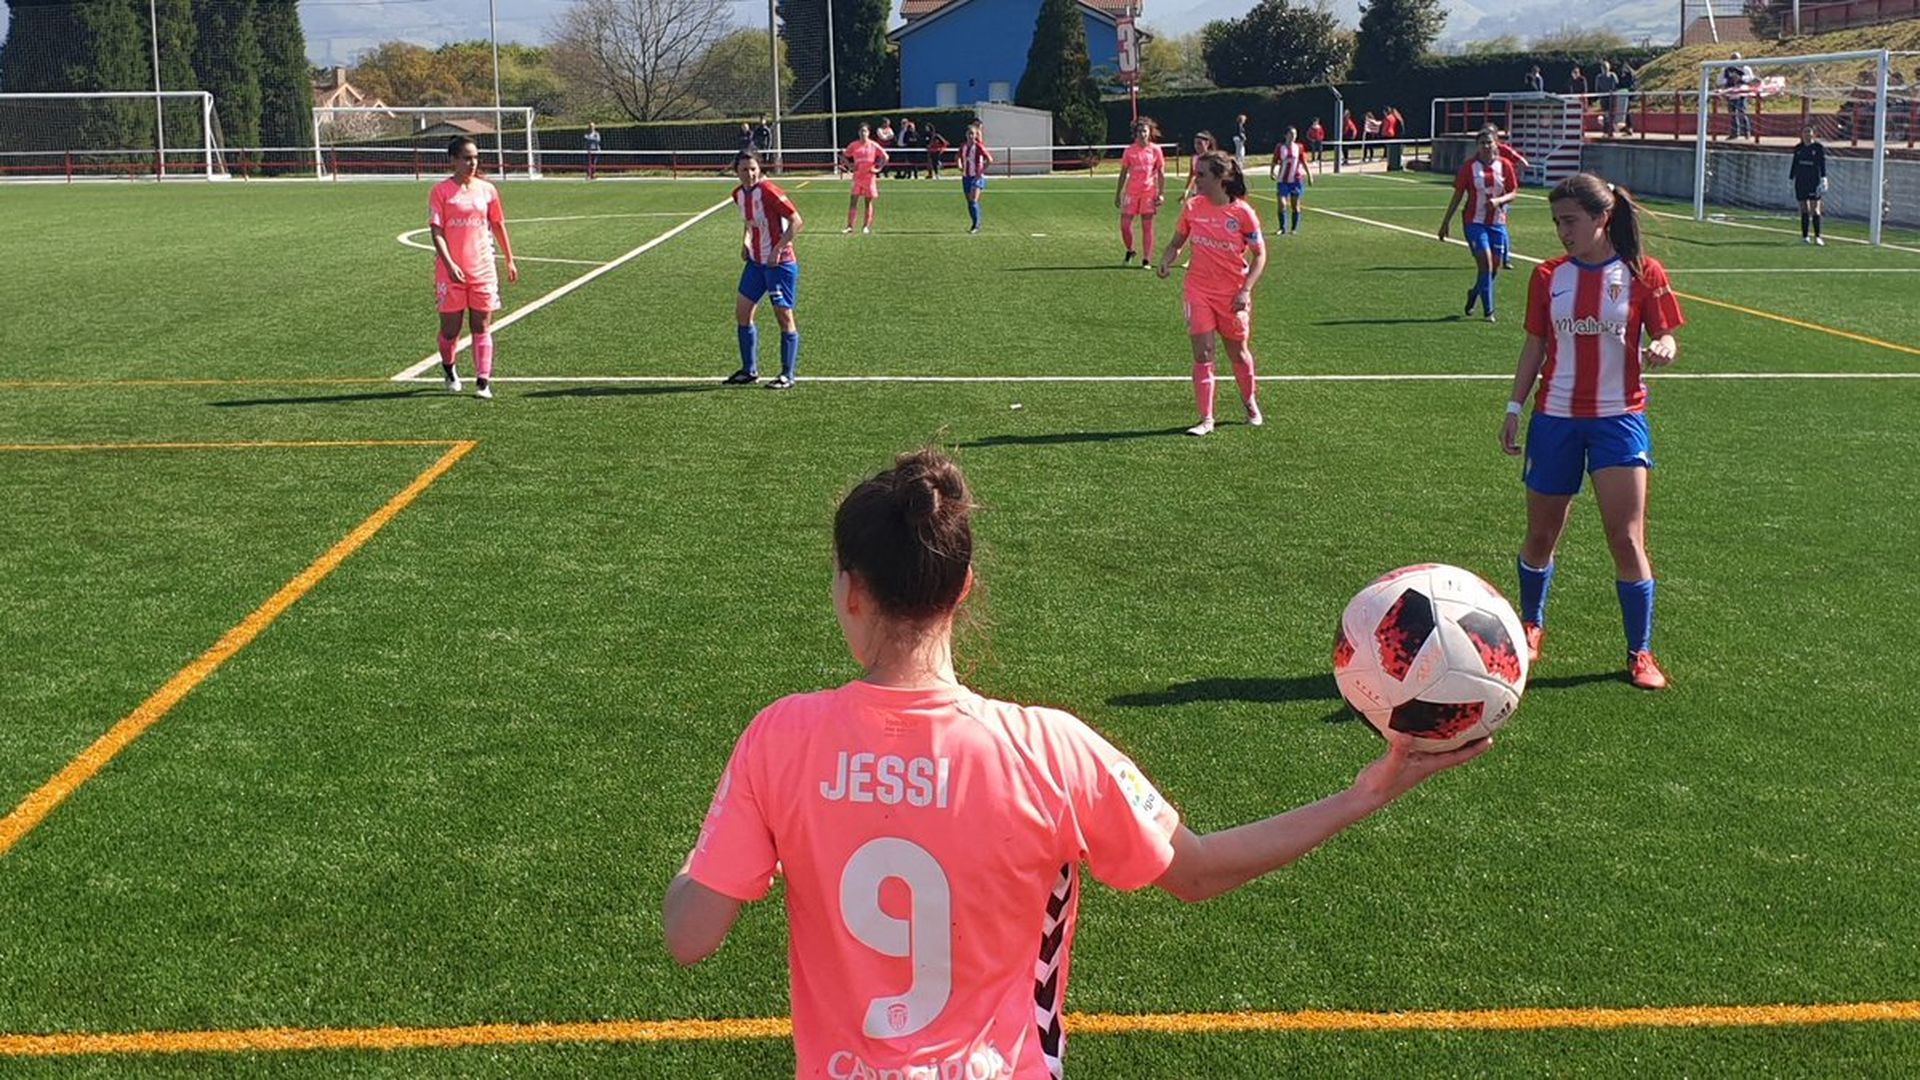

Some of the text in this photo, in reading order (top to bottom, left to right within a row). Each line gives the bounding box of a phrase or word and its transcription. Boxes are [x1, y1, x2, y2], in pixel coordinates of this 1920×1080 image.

[1117, 23, 1136, 72] 3
[819, 751, 949, 809] JESSI
[839, 836, 952, 1039] 9
